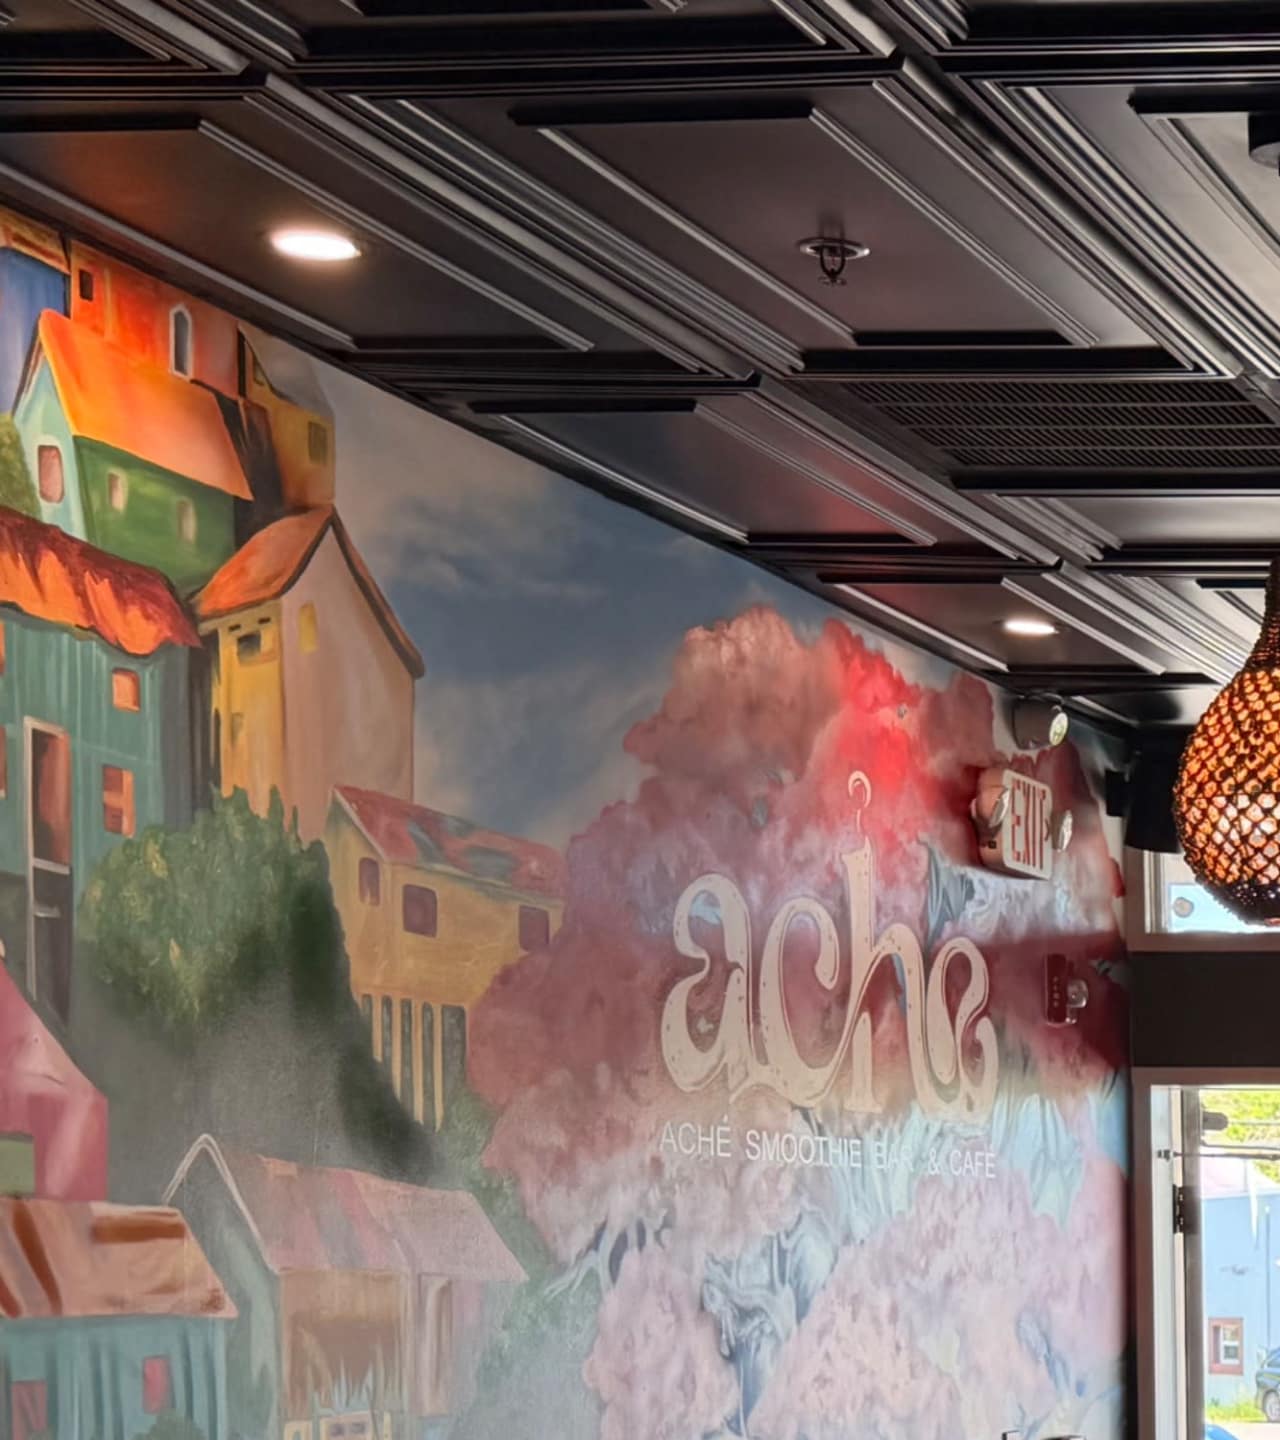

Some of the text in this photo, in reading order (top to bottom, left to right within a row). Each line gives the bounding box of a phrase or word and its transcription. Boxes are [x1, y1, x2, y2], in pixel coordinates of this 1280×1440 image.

[1010, 778, 1047, 870] EXIT
[660, 1116, 731, 1158] ACHÉ
[745, 1131, 862, 1169] SMOOTHIE
